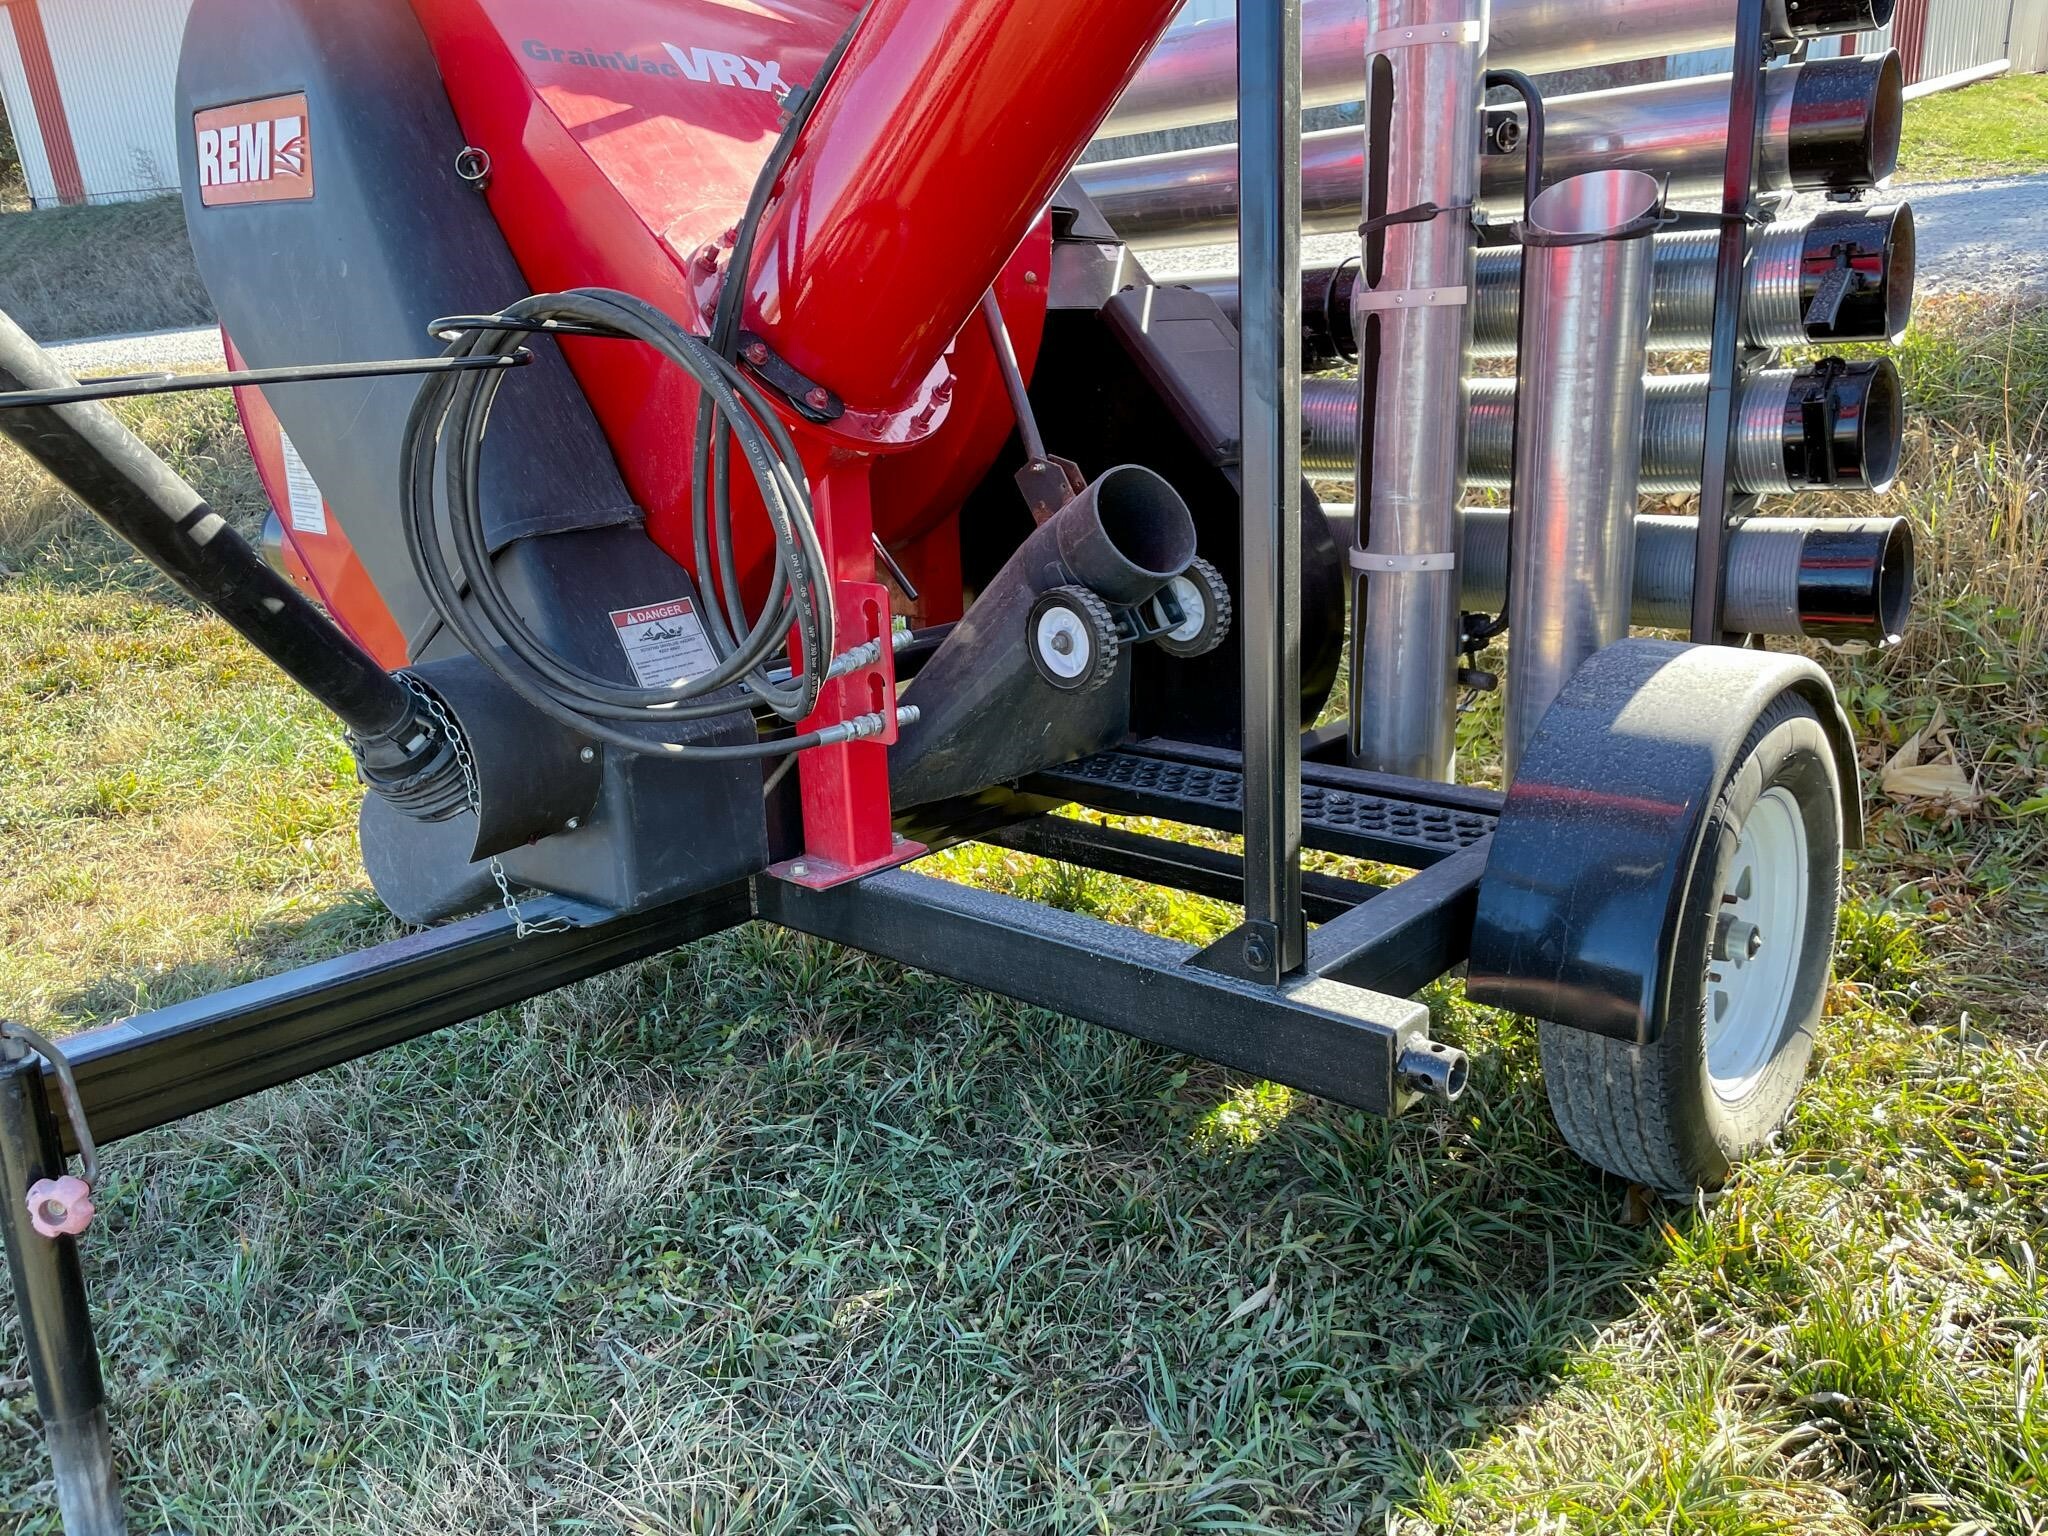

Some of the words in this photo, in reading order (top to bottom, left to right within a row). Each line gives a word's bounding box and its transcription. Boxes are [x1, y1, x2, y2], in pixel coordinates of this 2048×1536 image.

[521, 39, 679, 78] GrainVac
[661, 41, 791, 93] VRX
[199, 120, 271, 187] REM
[748, 439, 759, 454] ISO
[791, 553, 800, 567] DN
[795, 569, 803, 579] 10
[636, 604, 683, 622] DANGER
[808, 625, 816, 638] WP
